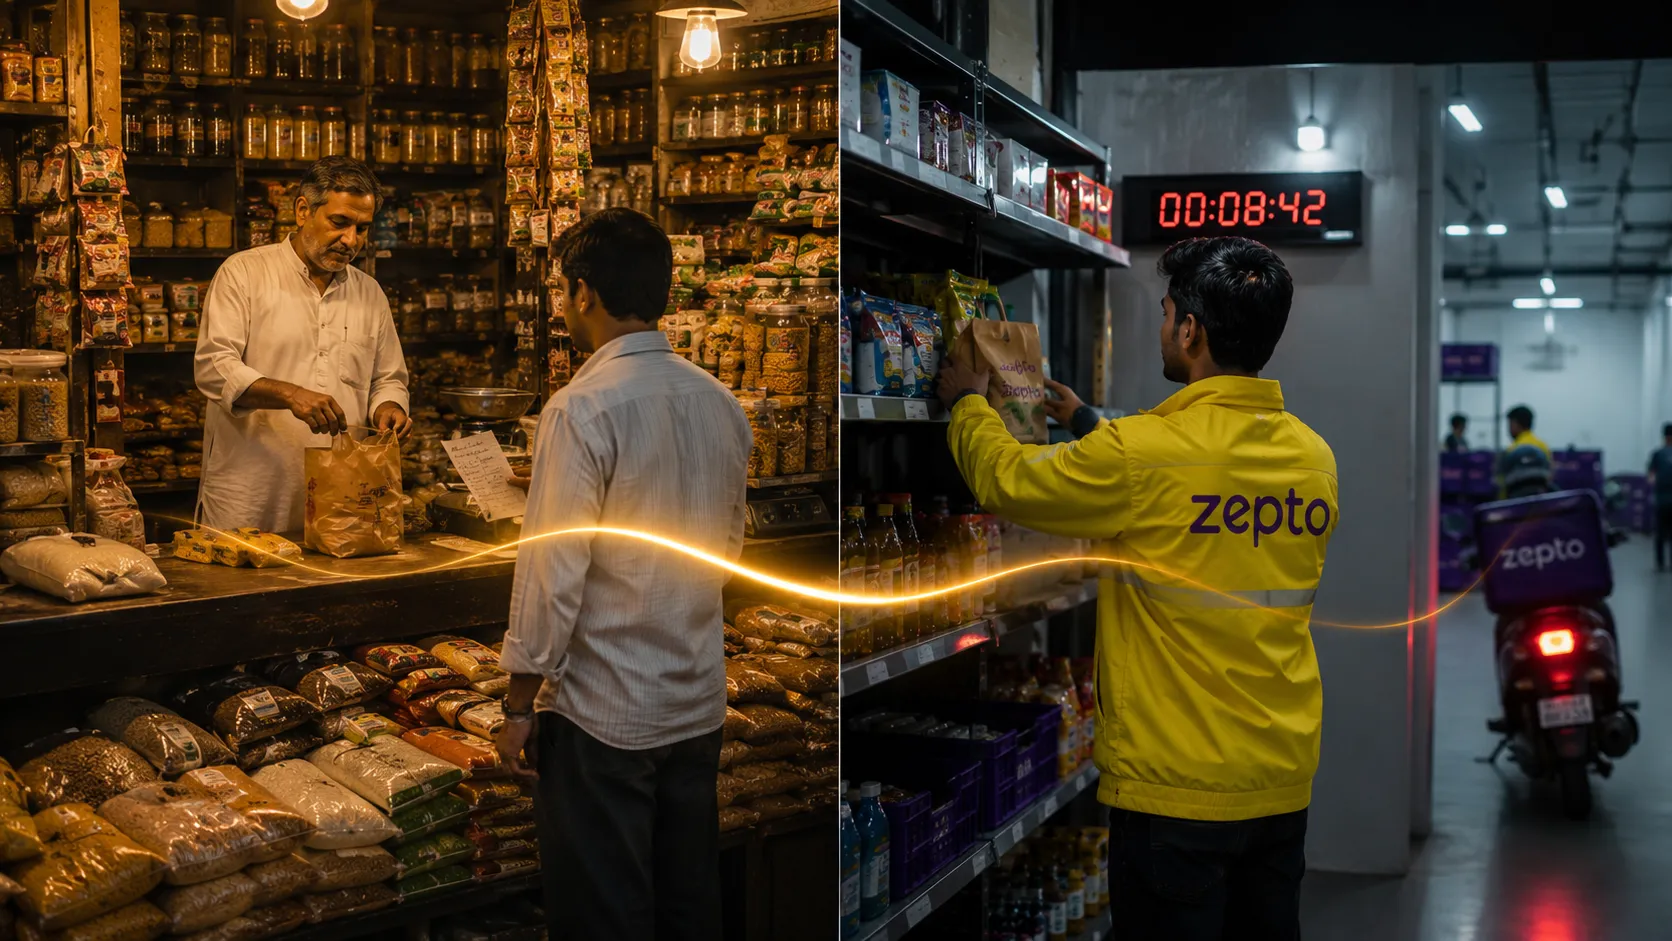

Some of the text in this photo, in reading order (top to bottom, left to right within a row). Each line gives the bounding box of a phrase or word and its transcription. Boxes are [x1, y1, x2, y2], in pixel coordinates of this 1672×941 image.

[1159, 190, 1326, 227] 00:08:42
[1190, 488, 1330, 547] zepto
[1500, 538, 1585, 570] zepto
